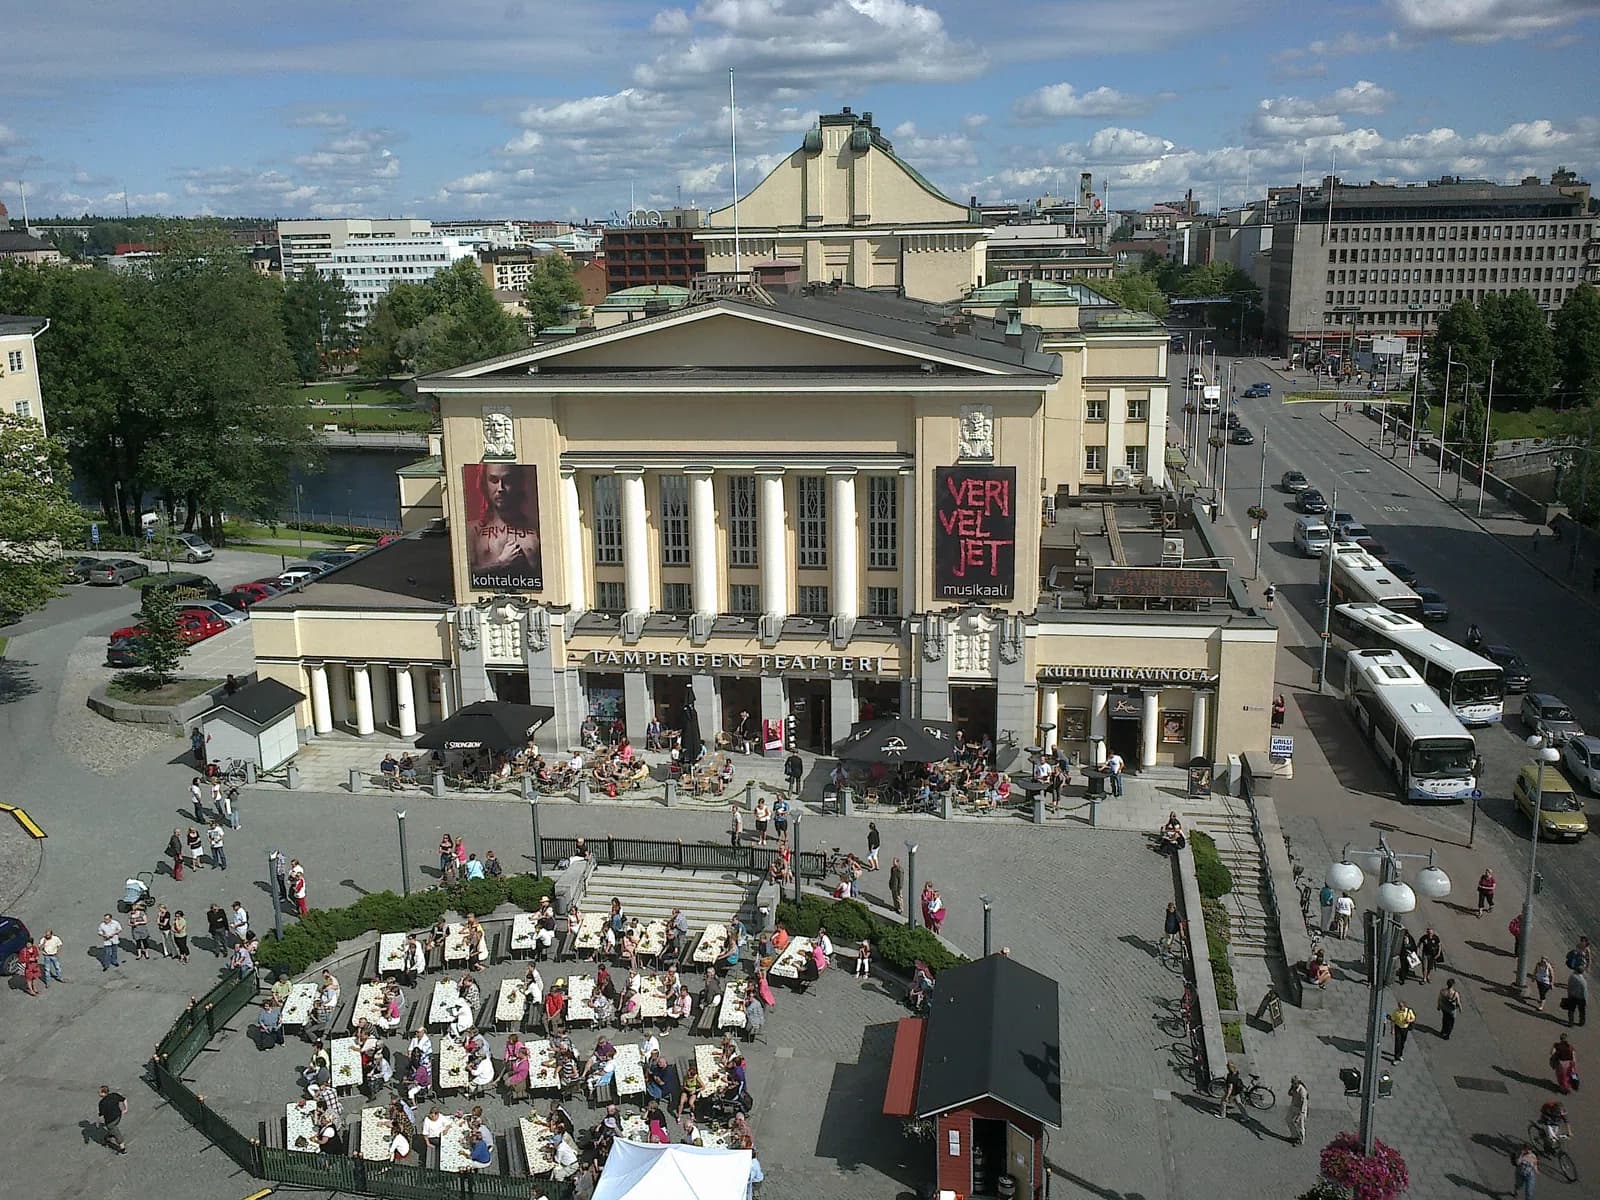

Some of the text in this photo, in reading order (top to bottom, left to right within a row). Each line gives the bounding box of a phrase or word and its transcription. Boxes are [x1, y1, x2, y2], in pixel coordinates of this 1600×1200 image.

[946, 475, 1009, 517] VERI
[938, 508, 991, 538] VEL
[952, 538, 1014, 577] JET
[472, 573, 542, 587] kohtalokas
[943, 584, 1008, 596] musikaali
[591, 650, 882, 671] TAMPEREEN TEATTERI
[1044, 666, 1209, 681] KULTTUURIRAVINTOLA
